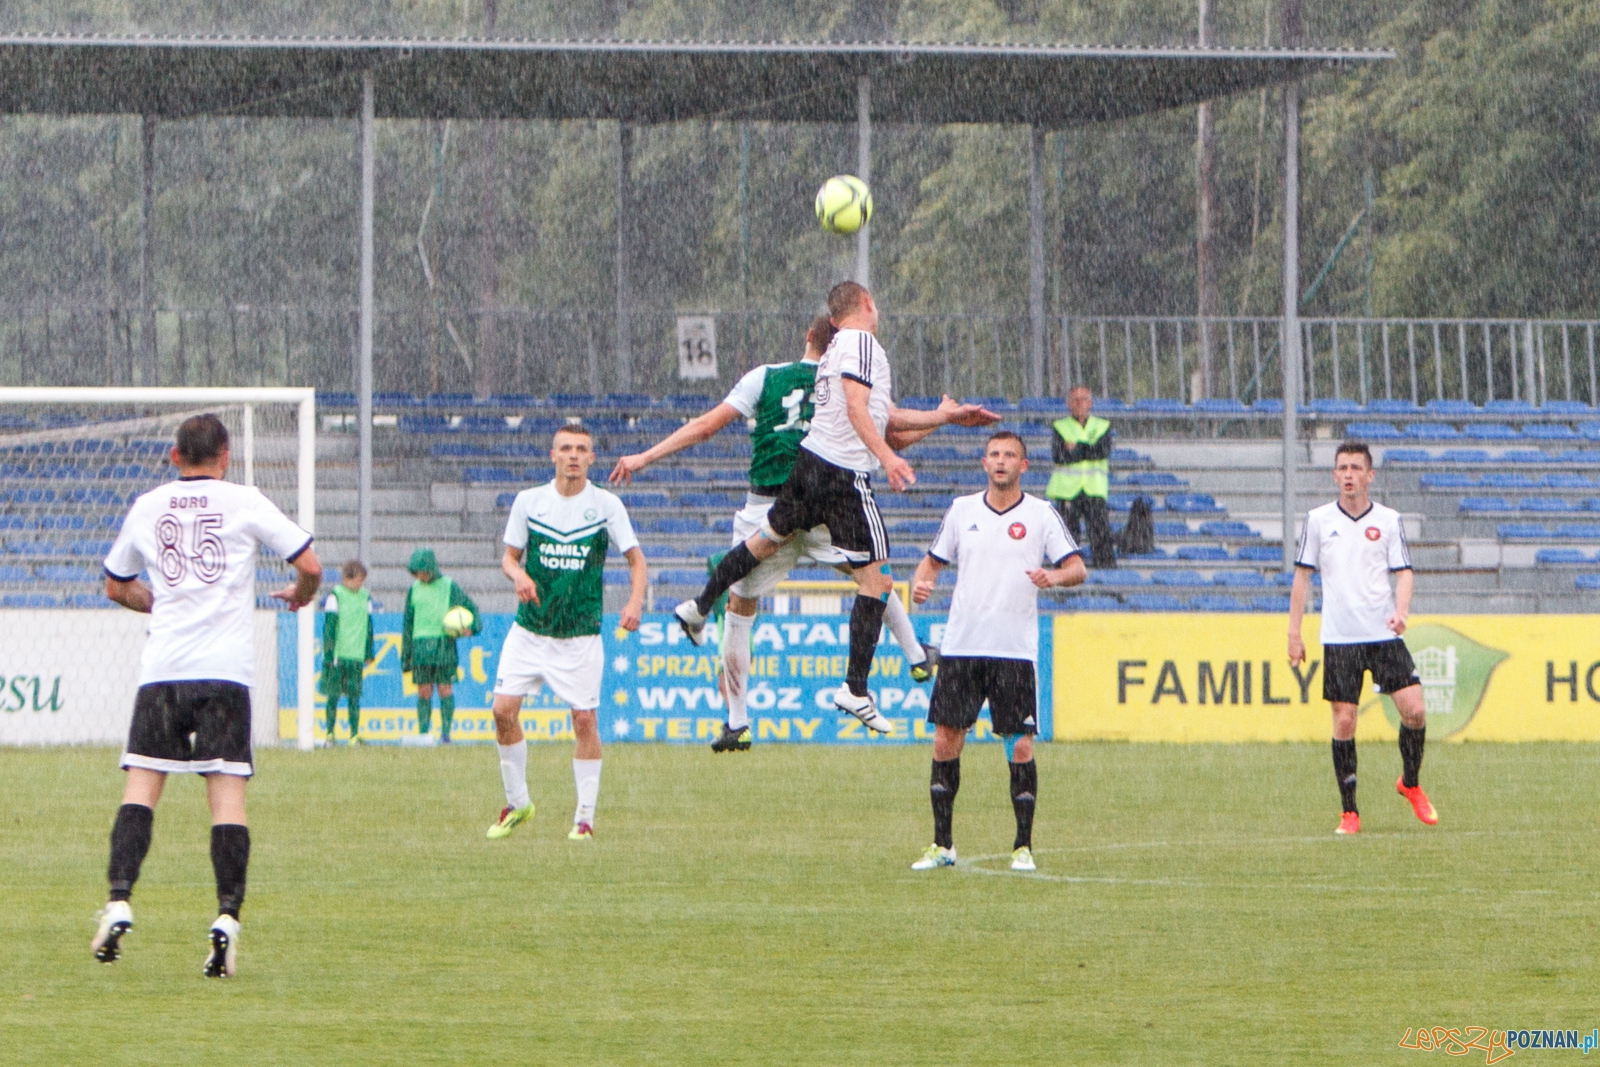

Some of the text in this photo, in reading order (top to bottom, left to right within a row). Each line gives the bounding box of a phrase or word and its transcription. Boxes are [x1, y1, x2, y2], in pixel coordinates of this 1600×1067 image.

[155, 513, 226, 587] 85
[0, 675, 64, 713] su
[1117, 660, 1320, 704] FAMILY
[636, 717, 821, 739] TERNY
